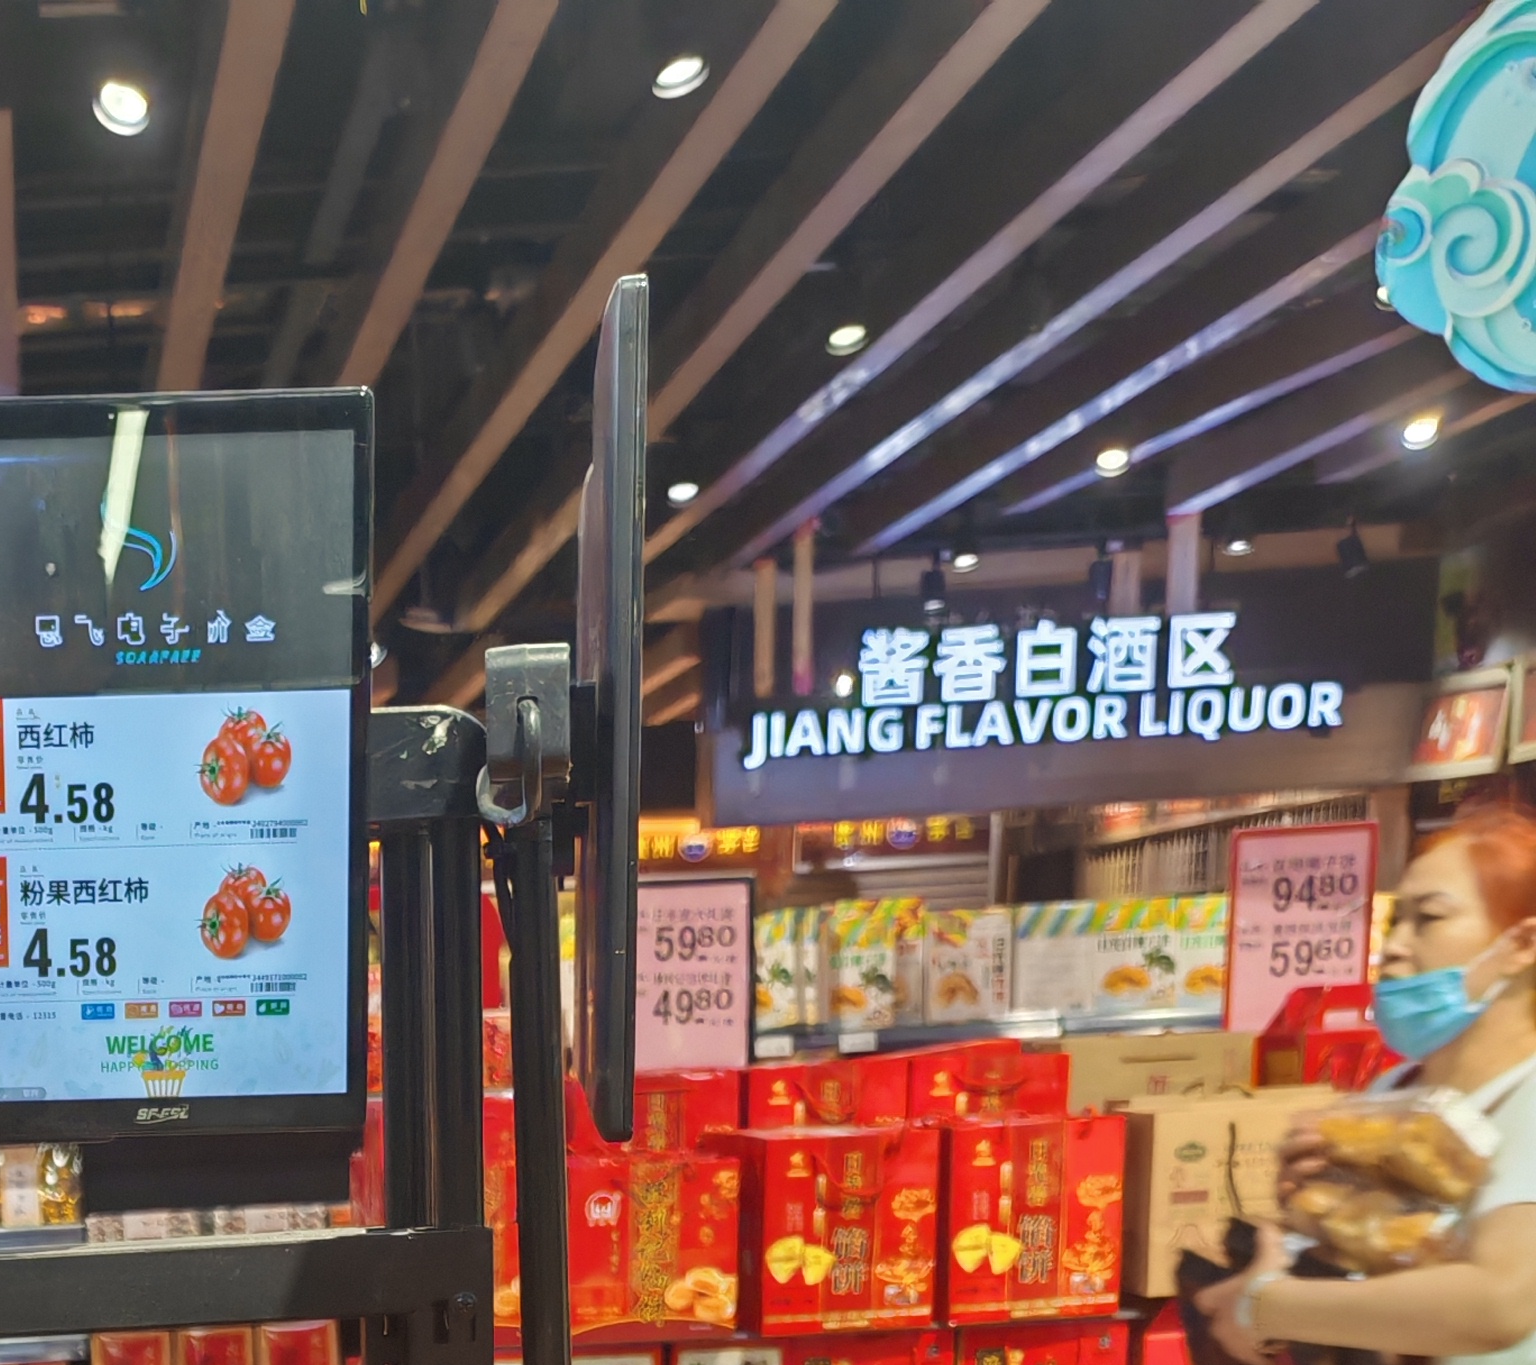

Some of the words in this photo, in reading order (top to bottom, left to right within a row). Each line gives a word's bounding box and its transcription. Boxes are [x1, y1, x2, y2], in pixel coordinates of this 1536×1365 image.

[858, 611, 1237, 708] 酱香白酒区
[16, 721, 95, 750] 西红柿
[744, 706, 904, 770] JIANG
[915, 695, 1129, 751] FLAVOR
[1139, 682, 1344, 742] LIQUOR
[20, 773, 115, 824] 4.58
[20, 876, 149, 906] 粉果西红柿
[23, 927, 117, 978] 4.58
[105, 1033, 215, 1056] WELCOME
